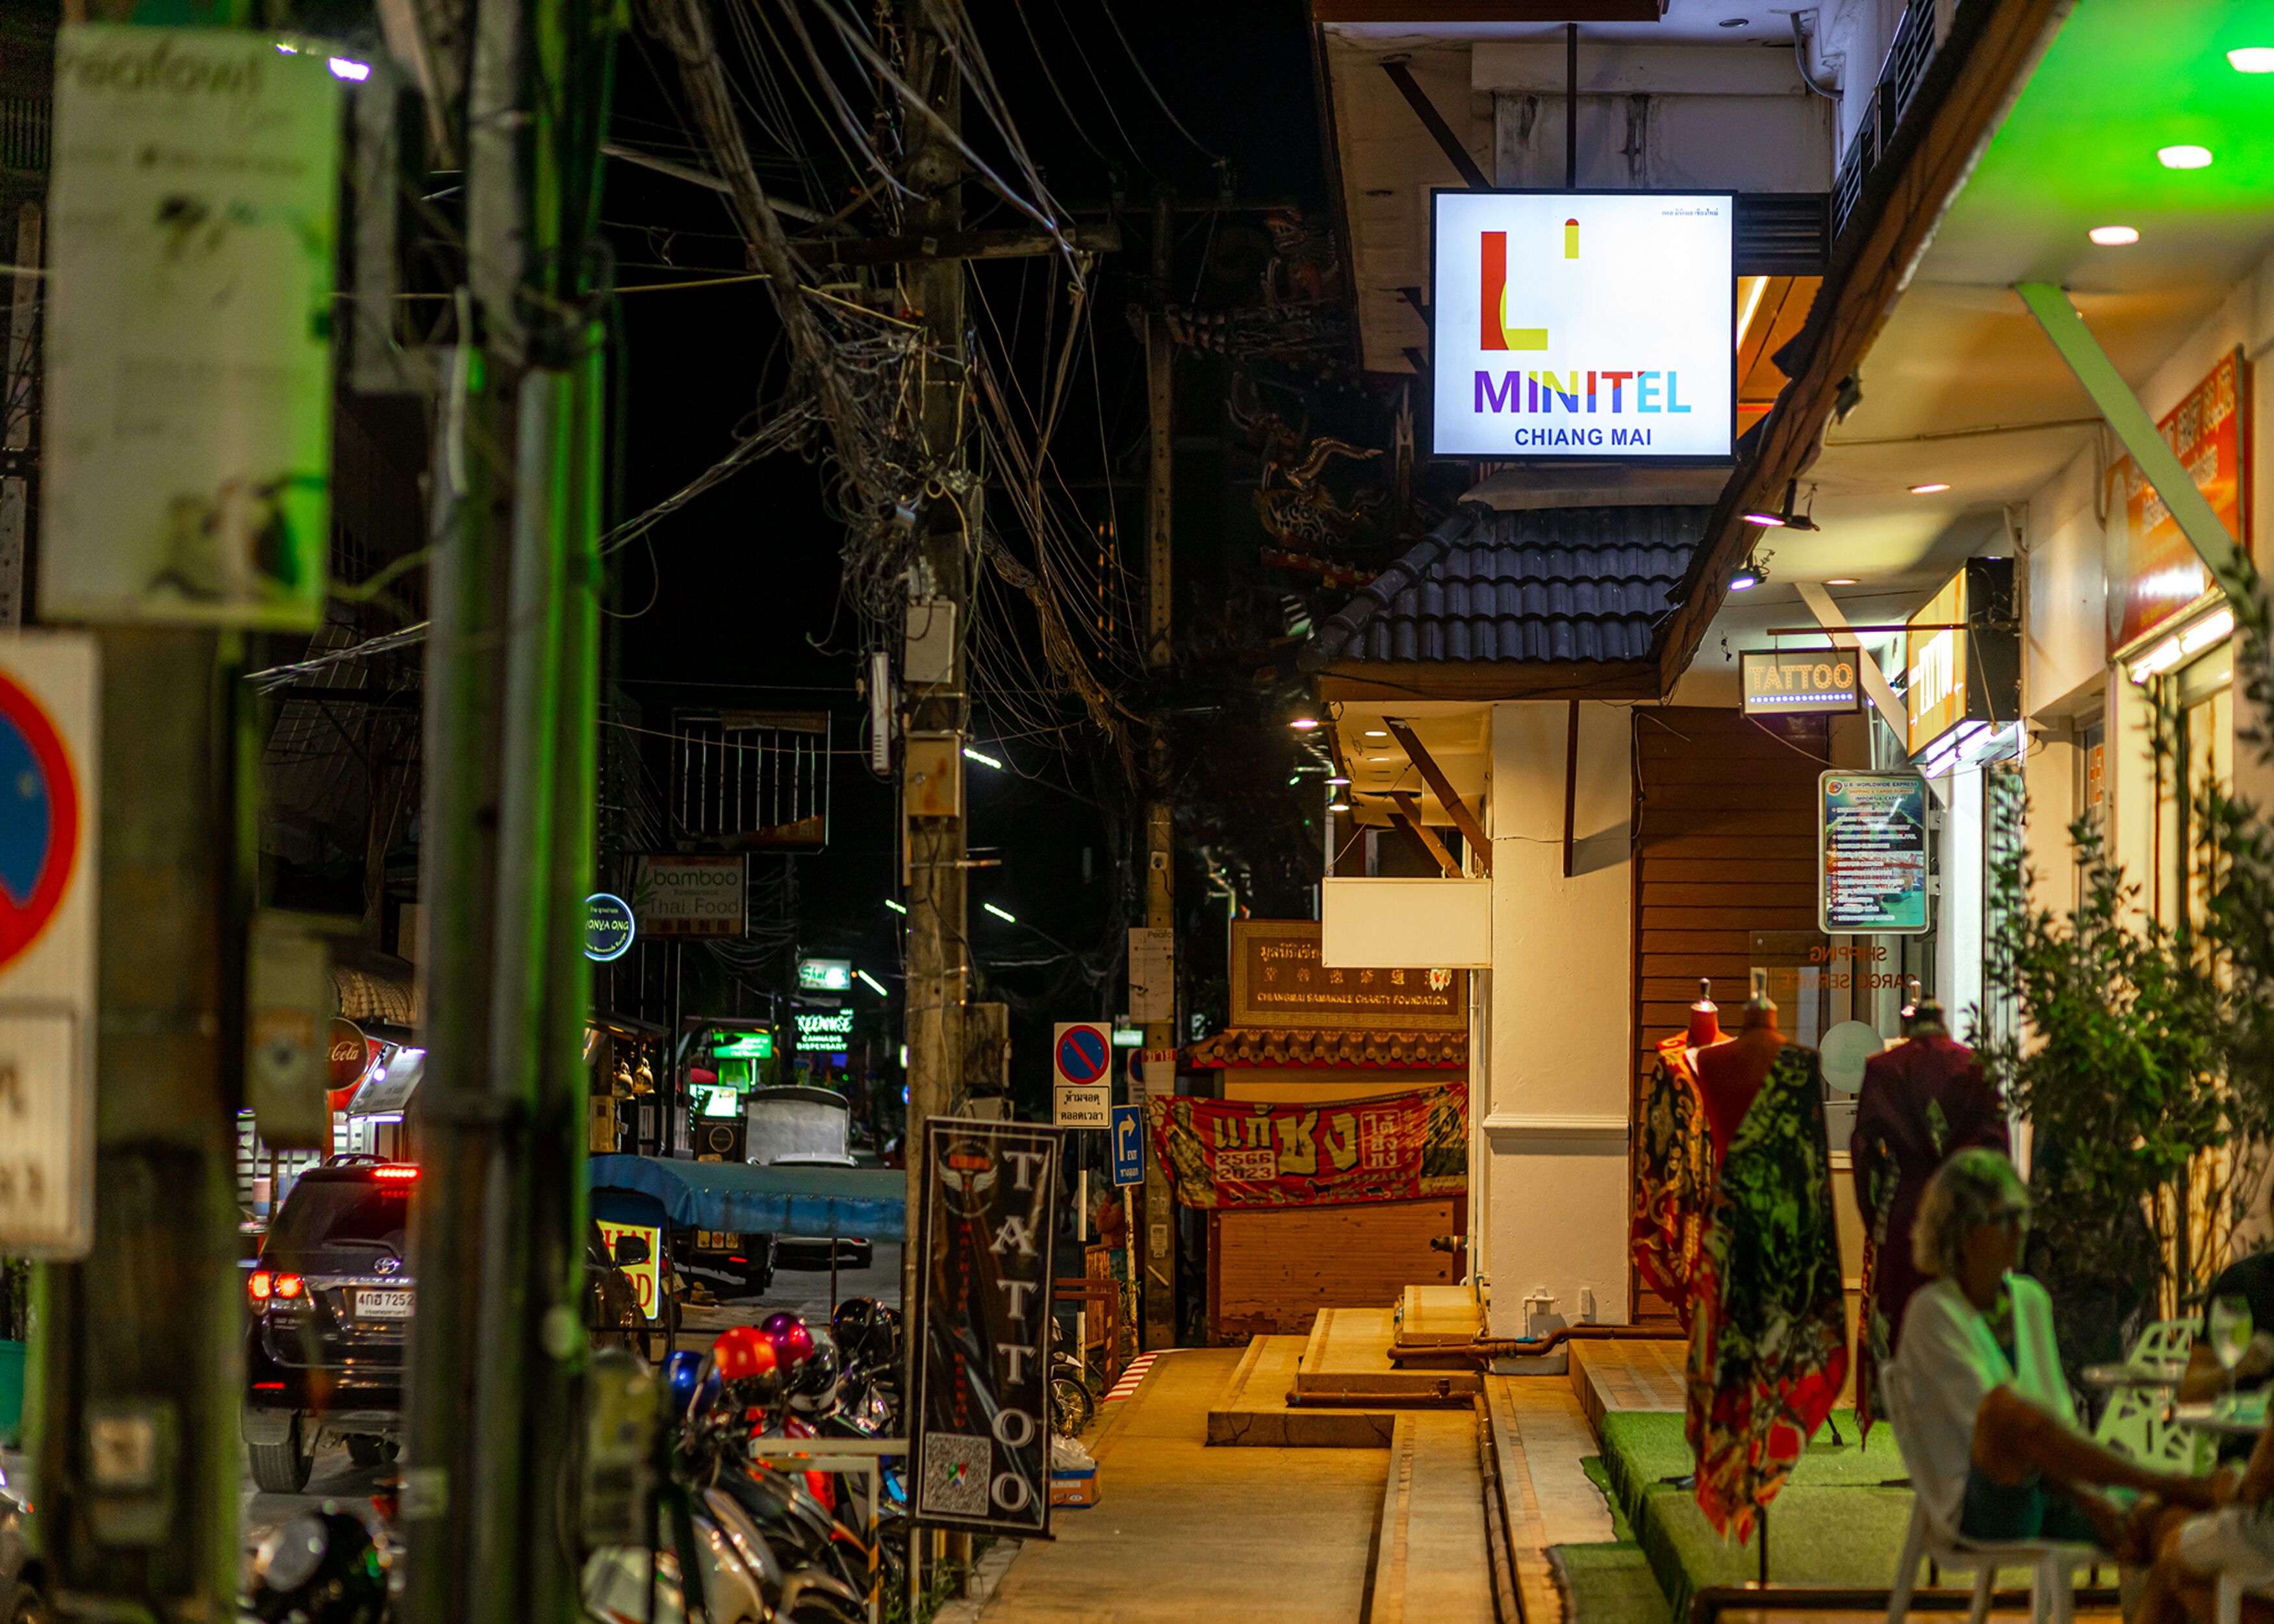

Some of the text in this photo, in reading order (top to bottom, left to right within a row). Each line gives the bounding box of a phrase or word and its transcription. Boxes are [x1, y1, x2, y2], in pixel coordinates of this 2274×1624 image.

[1474, 371, 1691, 413] MINITEL
[1514, 427, 1652, 446] CHIANG MAI
[1749, 663, 1853, 691] TATTOO
[654, 869, 737, 886] bamboo
[650, 898, 739, 914] Thai Food
[585, 919, 611, 932] ONYA
[1147, 930, 1173, 939] Peafo
[1257, 992, 1305, 1003] CHIANGMAI
[1355, 994, 1390, 1004] CHARITY
[1393, 995, 1448, 1006] FOUNDATION
[332, 1041, 359, 1061] Cola
[1066, 1091, 1100, 1102] ห้ามจอด
[1061, 1111, 1103, 1121] ตลอดเวลา
[1127, 1150, 1138, 1161] EXIT
[1219, 1152, 1271, 1165] 2566
[1220, 1167, 1271, 1180] 2023
[385, 1293, 415, 1306] 7252
[988, 1150, 1045, 1512] TATTOO
